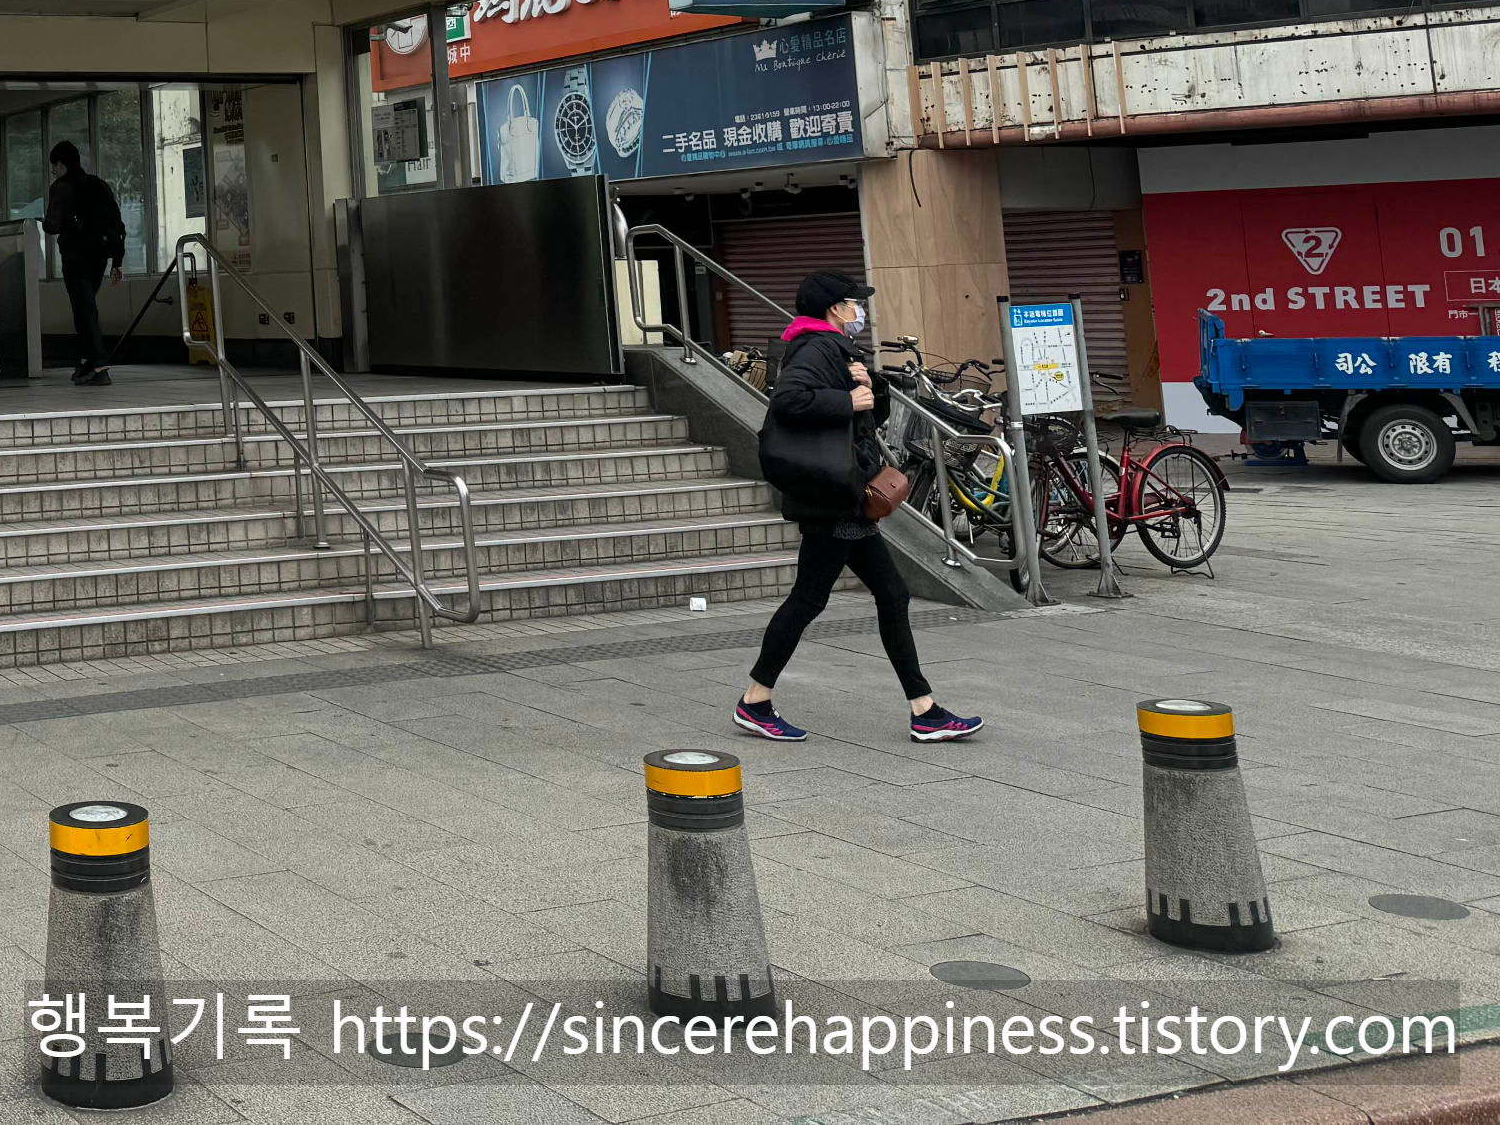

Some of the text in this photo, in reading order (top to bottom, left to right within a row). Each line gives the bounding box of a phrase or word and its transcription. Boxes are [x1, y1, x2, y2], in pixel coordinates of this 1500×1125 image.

[780, 27, 847, 54] 心愛精品名店
[662, 111, 854, 154] 二手名品 現金收購 歡迎寄賣
[1439, 226, 1485, 258] 01
[1206, 284, 1430, 312] 2nd STREET
